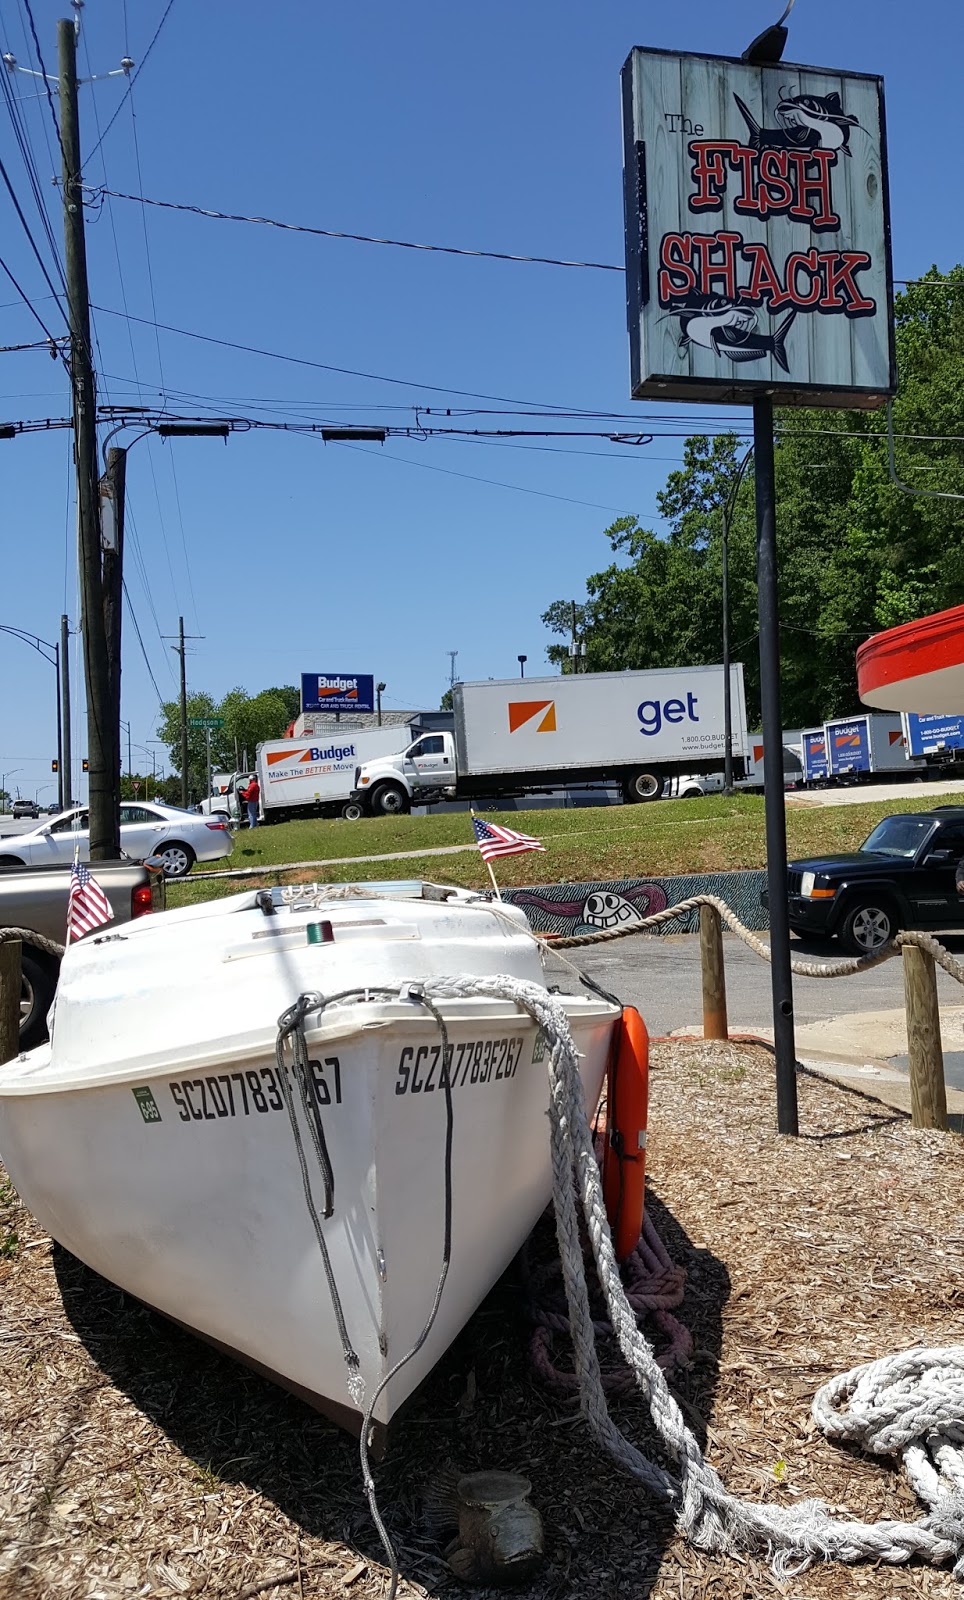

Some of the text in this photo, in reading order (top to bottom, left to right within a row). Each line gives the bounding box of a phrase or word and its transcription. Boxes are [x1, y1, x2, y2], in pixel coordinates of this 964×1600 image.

[664, 113, 704, 136] The
[689, 141, 840, 229] FISH
[660, 234, 875, 316] SHACK
[318, 676, 358, 691] Budget
[637, 692, 699, 736] get
[190, 719, 219, 727] Hodgson
[834, 725, 860, 735] Budget
[681, 733, 738, 743] 1.800.GO.BUDET
[682, 742, 740, 750] www.budget.m
[310, 745, 355, 761] Budget
[268, 762, 354, 779] Make The BETTER Move
